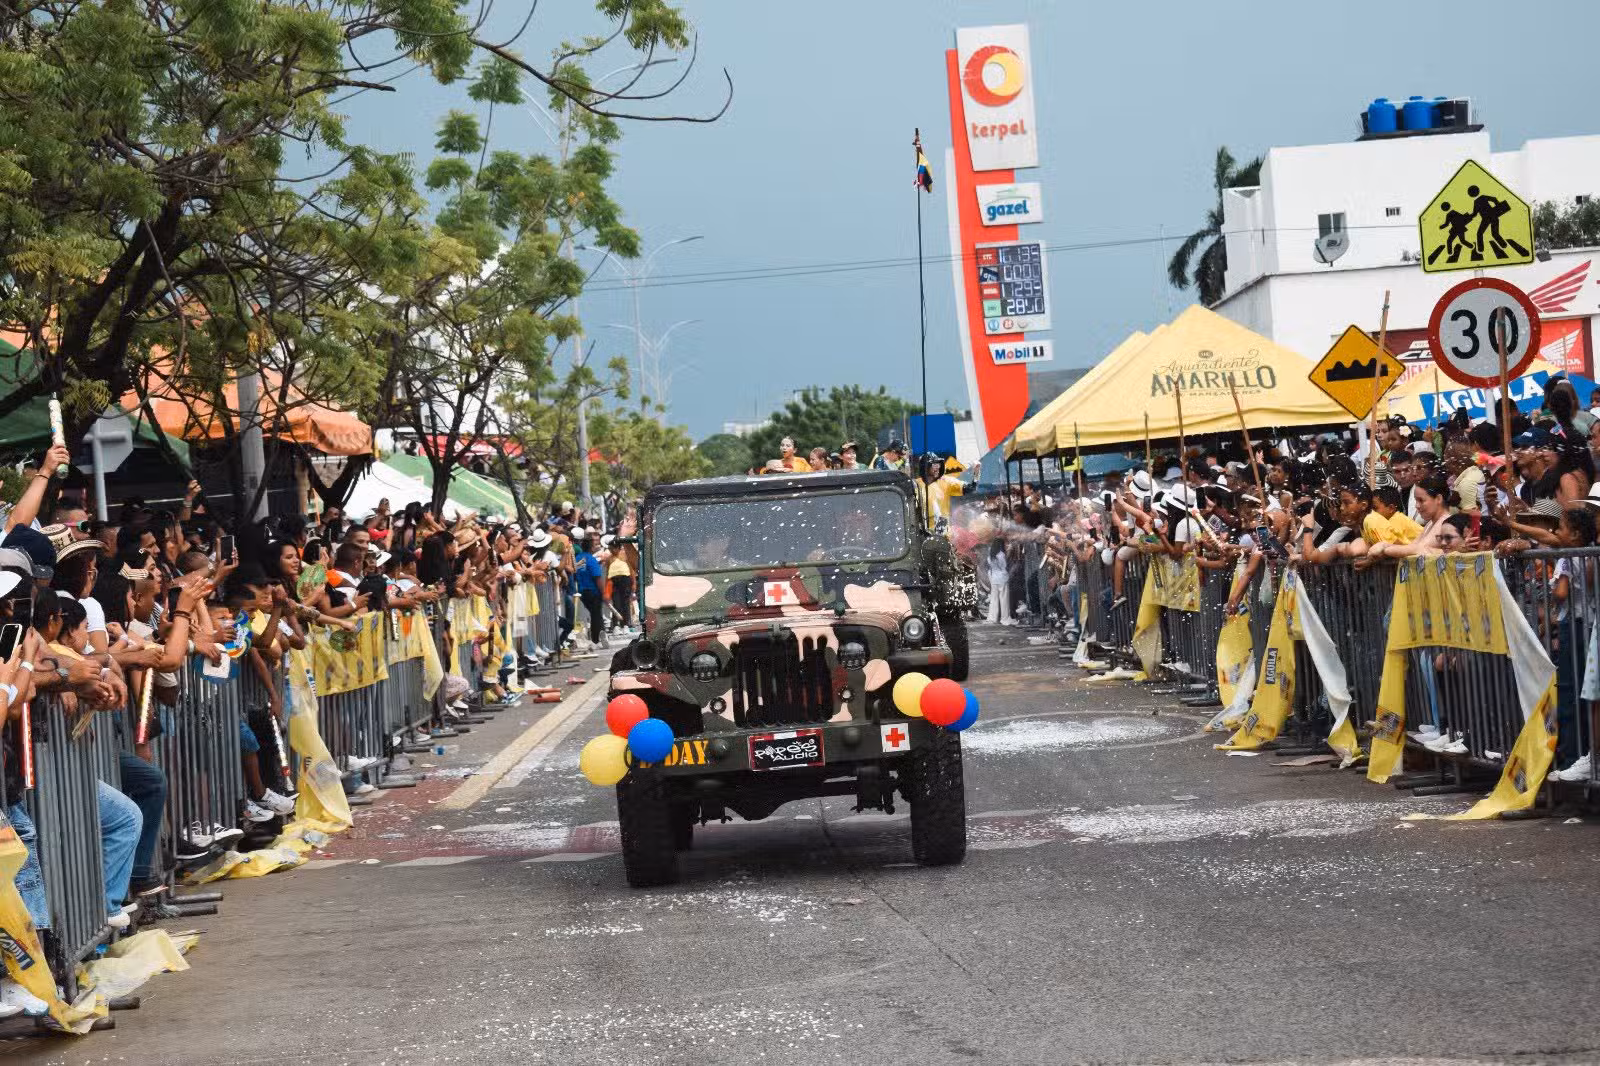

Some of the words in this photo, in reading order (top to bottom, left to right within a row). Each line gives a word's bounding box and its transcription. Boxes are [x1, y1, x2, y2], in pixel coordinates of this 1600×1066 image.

[971, 119, 1027, 140] terpel
[986, 200, 1029, 221] gazel
[1450, 306, 1519, 360] 30
[995, 346, 1030, 360] Mobil
[1034, 346, 1044, 357] 1
[1156, 349, 1260, 375] Aguardiente
[1151, 365, 1277, 398] AMARILLO
[1266, 649, 1278, 684] AGUILA
